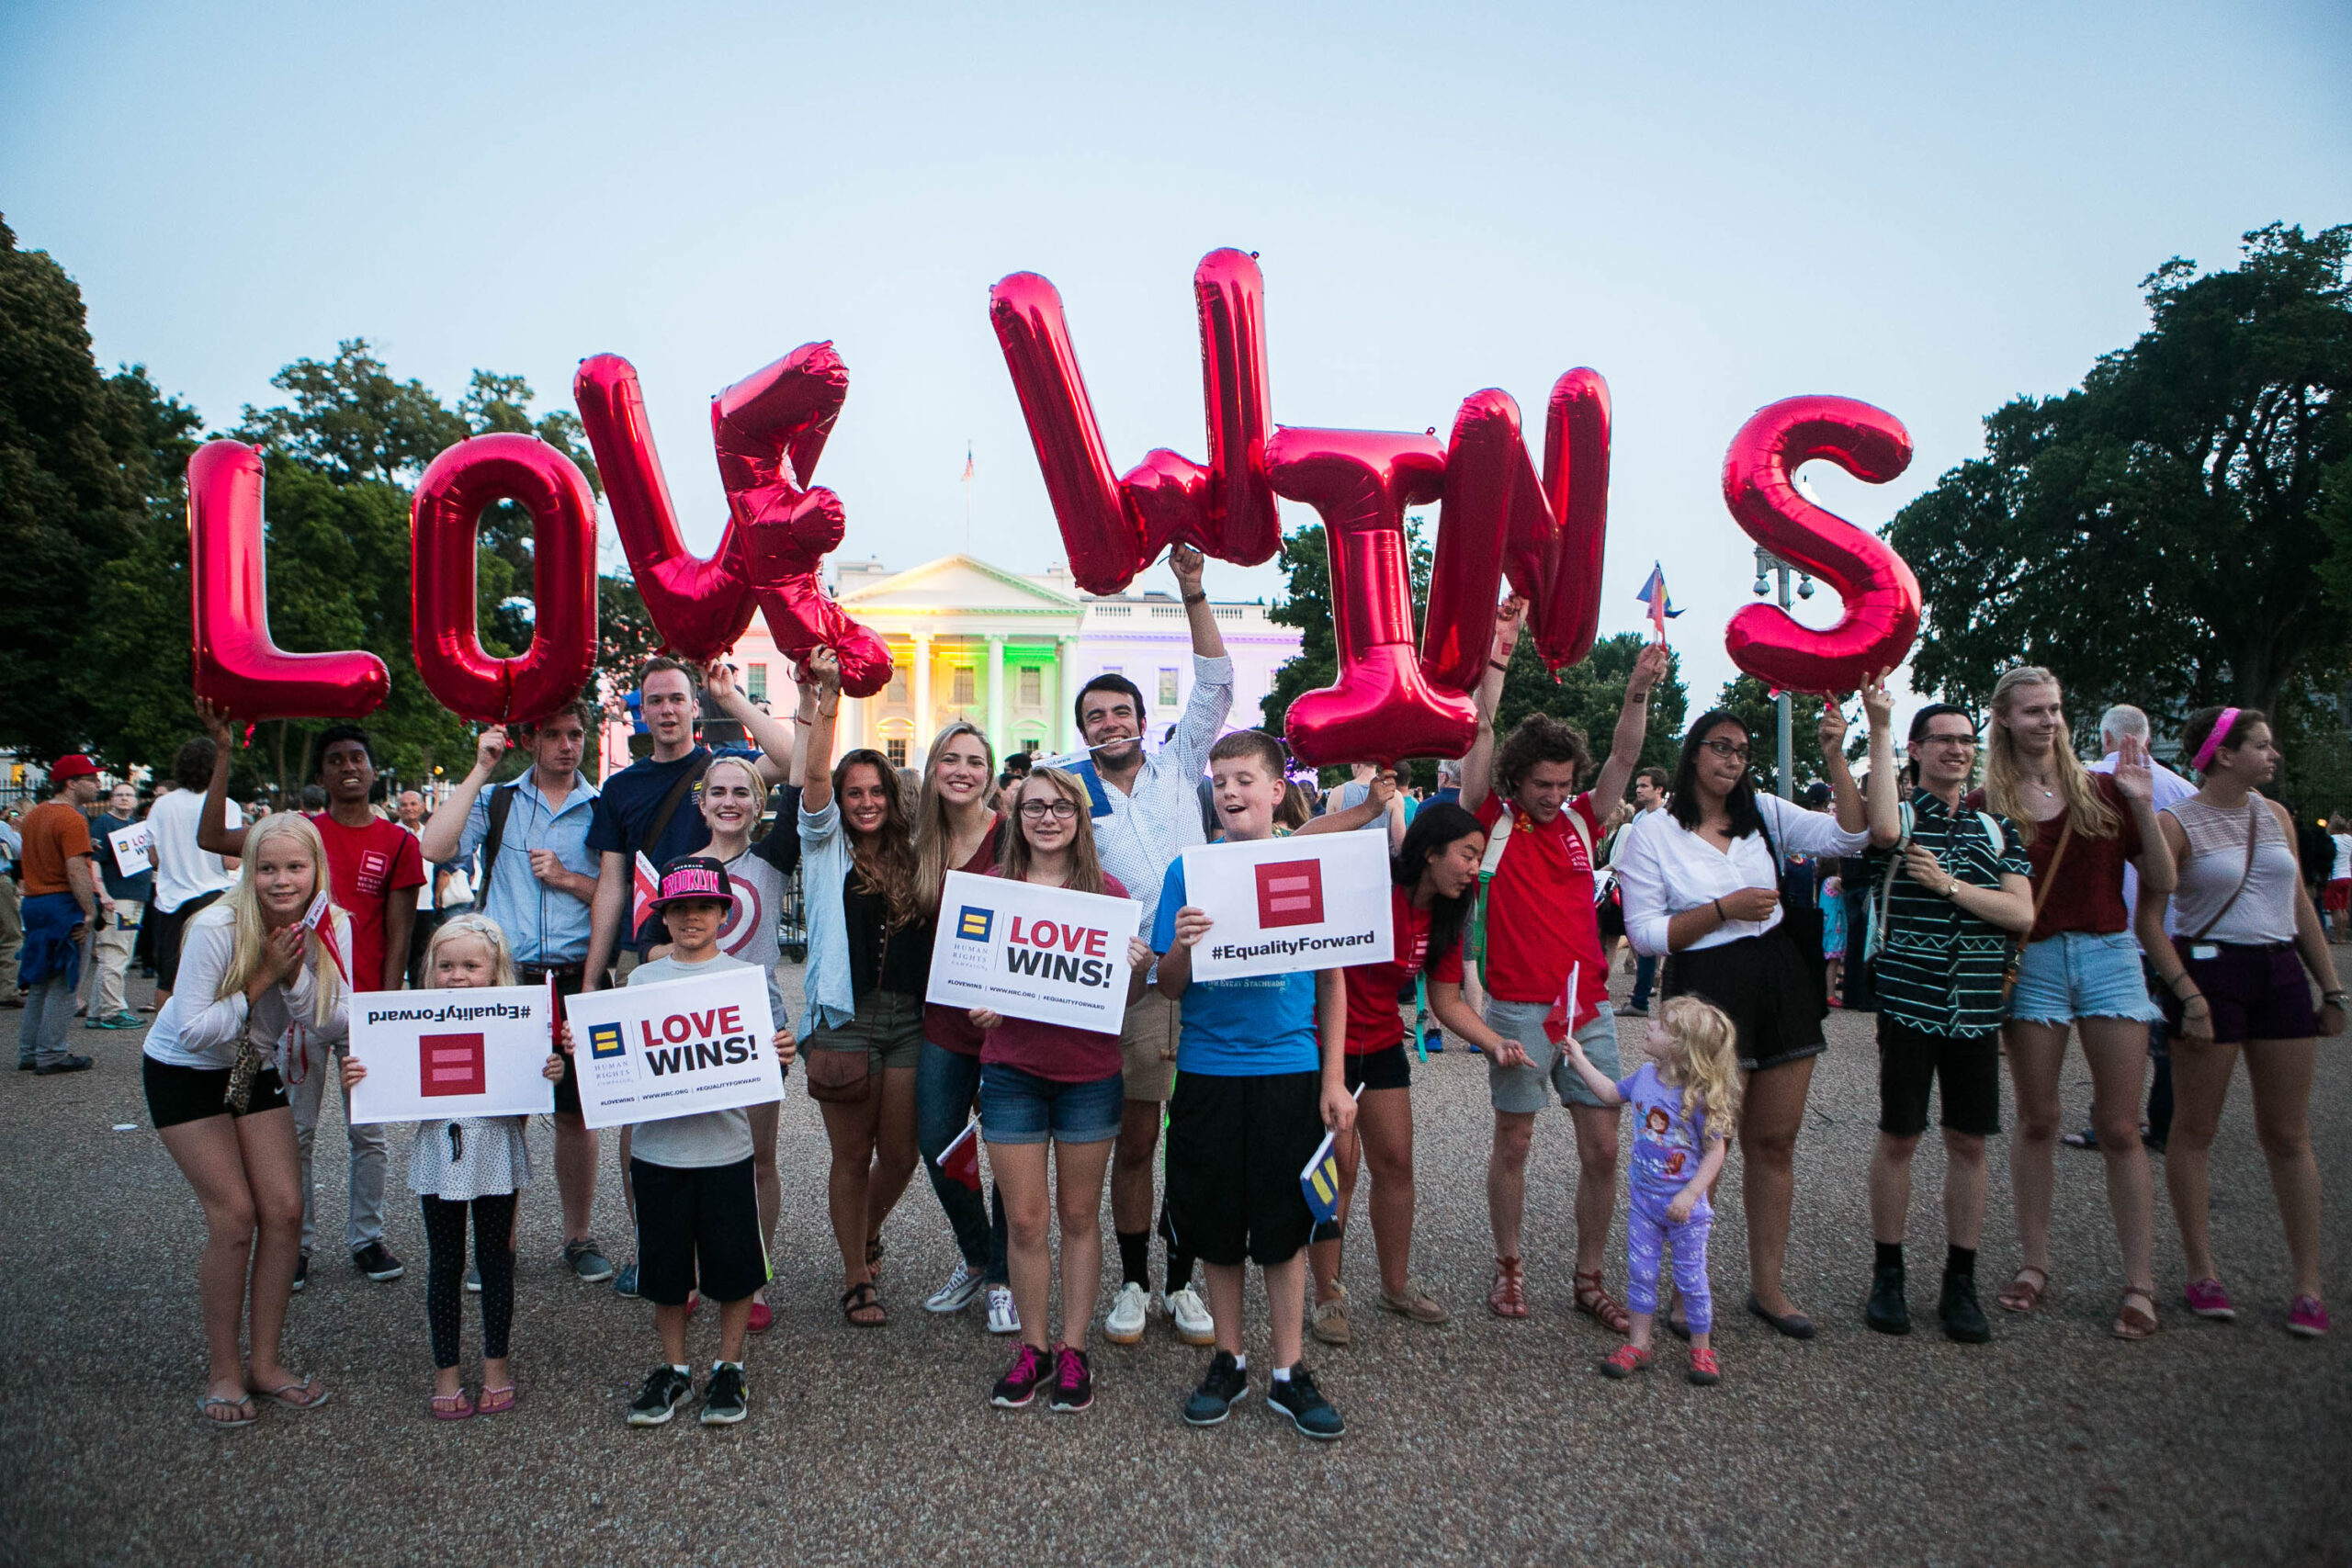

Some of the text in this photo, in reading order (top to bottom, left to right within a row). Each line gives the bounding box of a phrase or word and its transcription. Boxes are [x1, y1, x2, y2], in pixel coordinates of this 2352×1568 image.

[187, 247, 1922, 761] LOVE WINS
[662, 868, 720, 899] BROOKLYN
[954, 943, 989, 954] HUMAN
[1010, 916, 1109, 958] LOVE
[1211, 931, 1374, 961] #EqualityForward
[952, 952, 988, 963] RIGHTS
[1007, 946, 1114, 989] WINS!
[947, 979, 1105, 1010] #LOVEWINS WWW.HRC.ORG #EQUALITYFORWARD
[368, 1003, 531, 1025] #EqualityForward
[640, 1005, 744, 1047] LOVE
[594, 1061, 628, 1071] HUMAN
[645, 1034, 759, 1077] WINS!
[596, 1069, 630, 1080] RIGHTS
[600, 1077, 762, 1106] #LOVEWINS WWW.HRC.ORG #EQUALITYFORWARD
